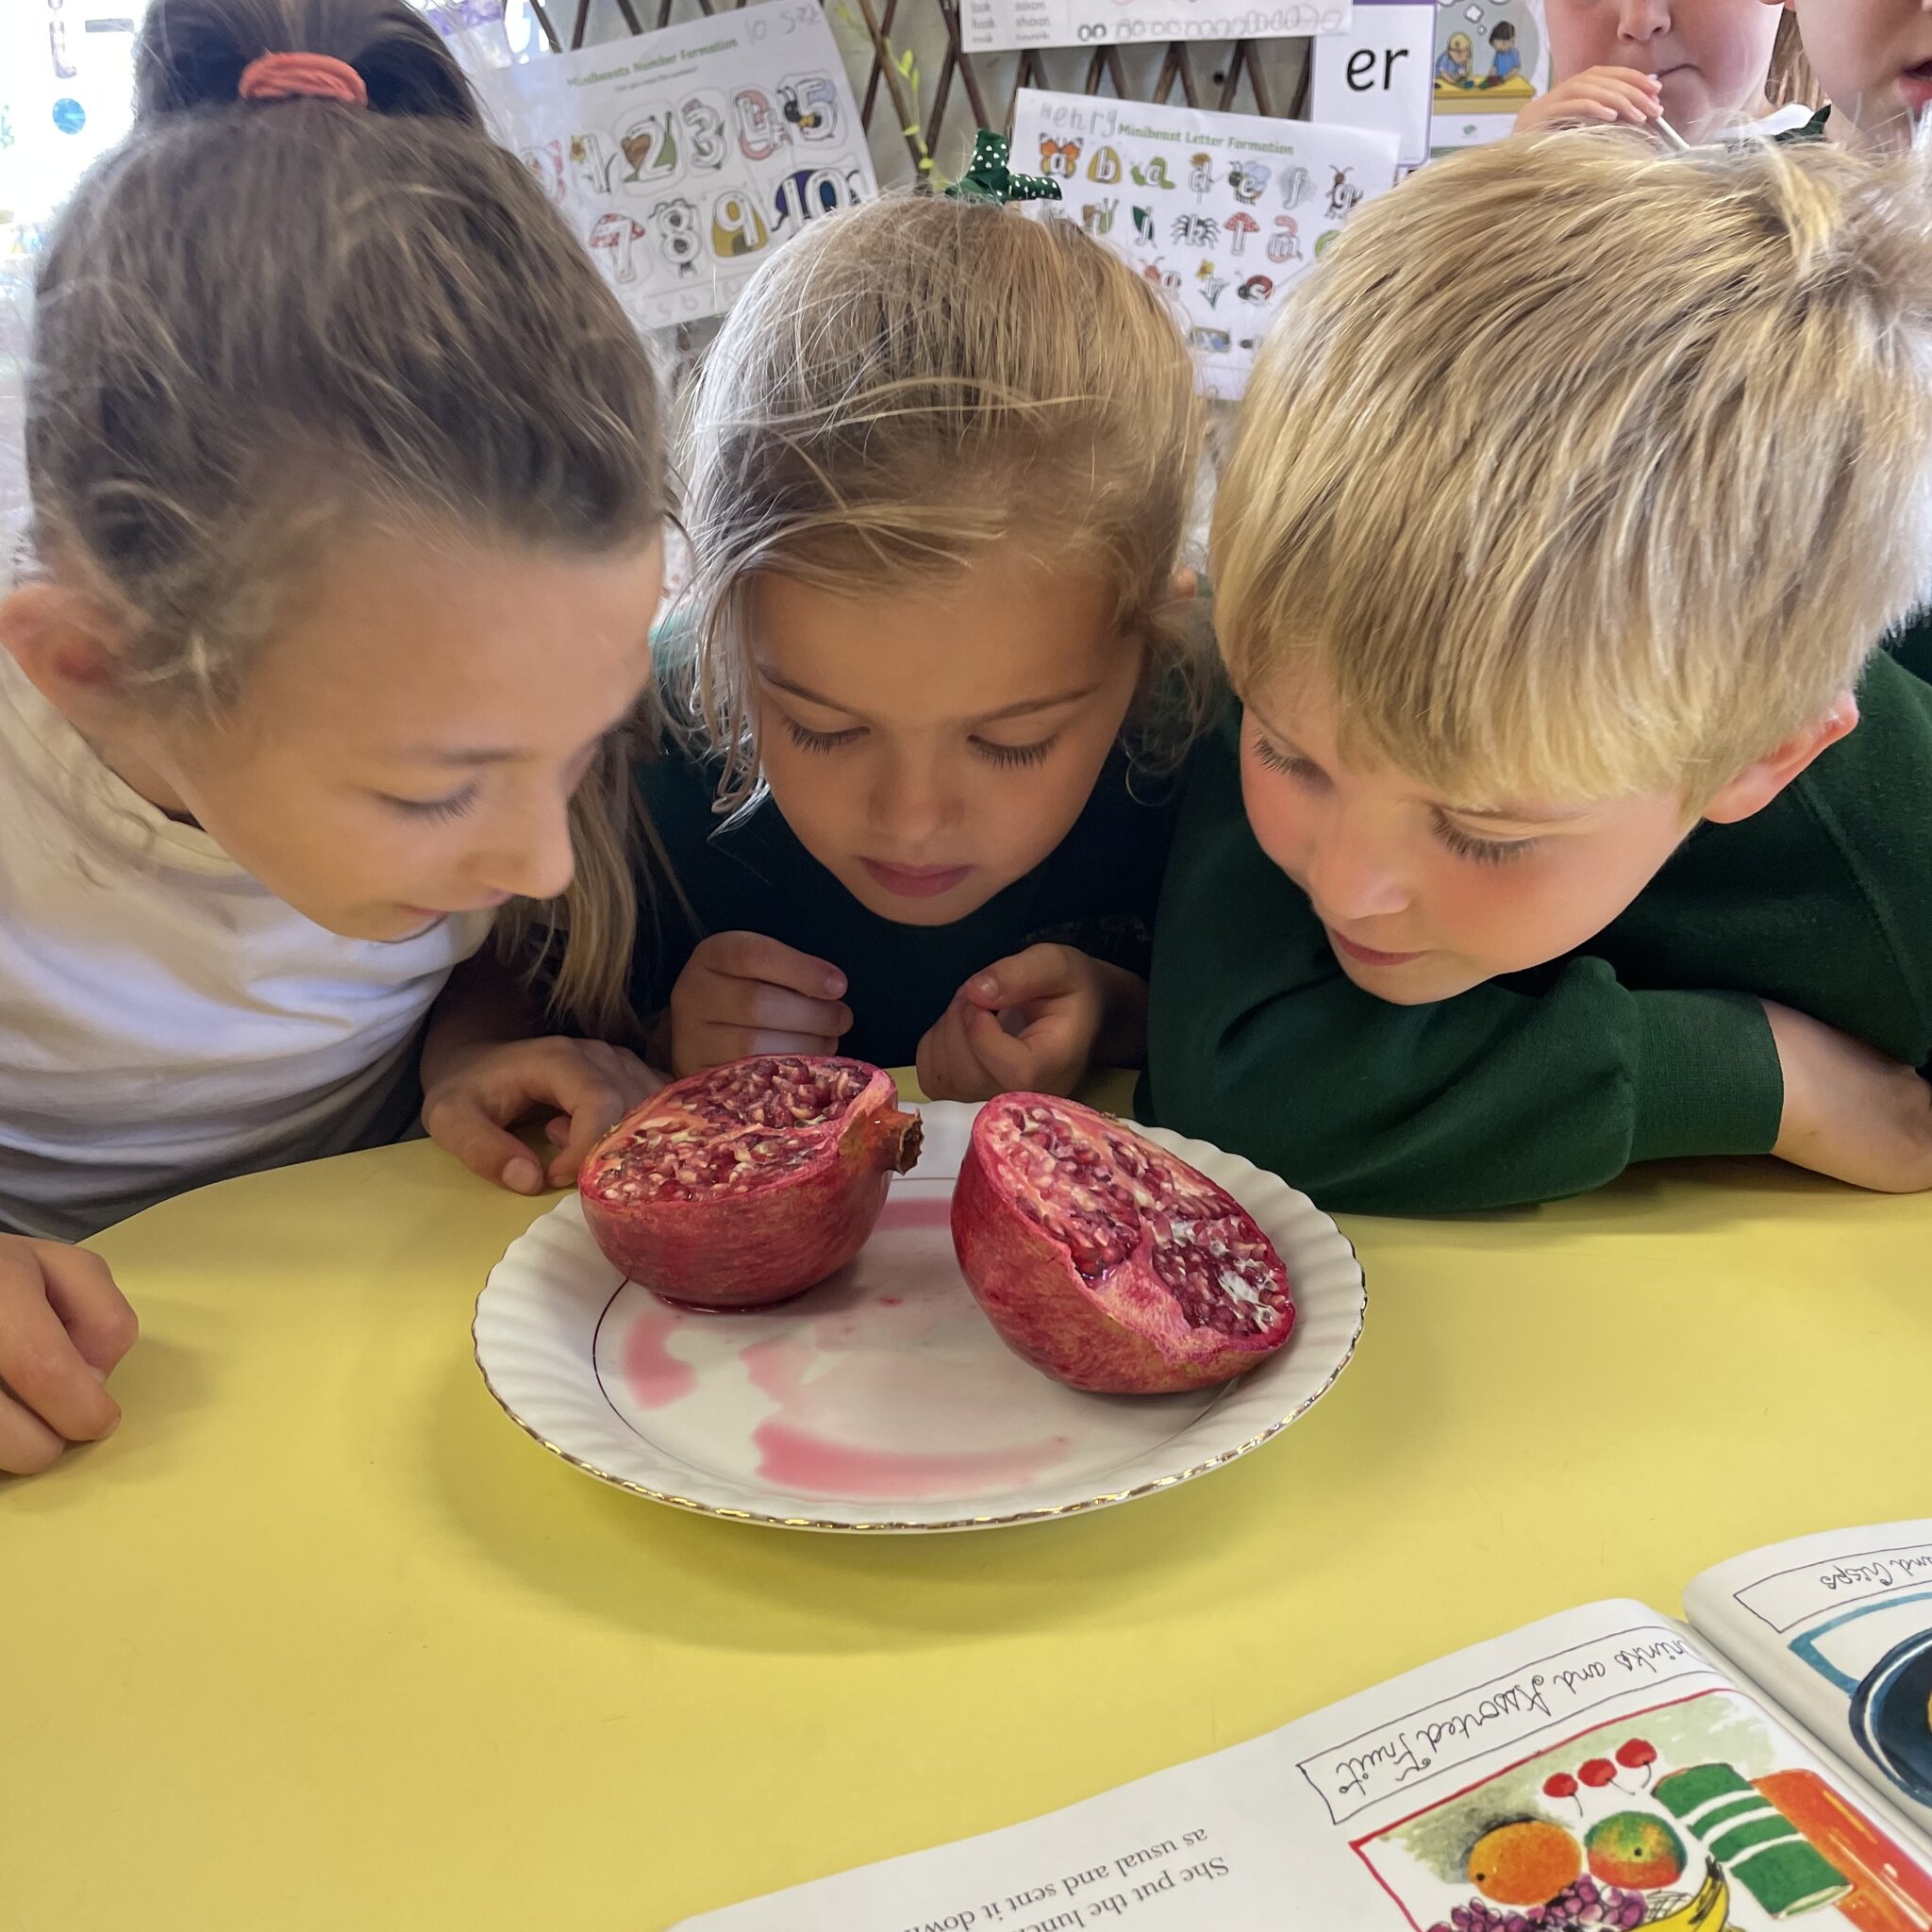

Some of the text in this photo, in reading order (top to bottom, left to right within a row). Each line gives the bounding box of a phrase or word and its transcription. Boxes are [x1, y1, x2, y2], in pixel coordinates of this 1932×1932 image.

[633, 53, 677, 73] Number
[681, 38, 739, 59] Formation
[1346, 48, 1409, 91] er
[625, 119, 676, 182] 2
[686, 102, 726, 168] 3
[796, 78, 837, 141] 5
[1040, 102, 1118, 138] Henry
[1118, 123, 1294, 156] Minibeast Letter Formation
[658, 206, 702, 264] 8
[712, 191, 758, 246] 9
[781, 168, 849, 234] 10
[1820, 1562, 1893, 1590] Crisps
[1553, 1661, 1606, 1694] and
[1416, 1675, 1552, 1753] Assorted
[1336, 1732, 1431, 1795] Fruit
[1182, 1827, 1208, 1847] as
[1115, 1839, 1179, 1877] usual
[1182, 1857, 1230, 1879] She
[1061, 1864, 1110, 1897] and
[1131, 1869, 1176, 1903] put
[981, 1901, 1004, 1922] it
[1006, 1883, 1058, 1912] sent
[1088, 1891, 1129, 1918] the
